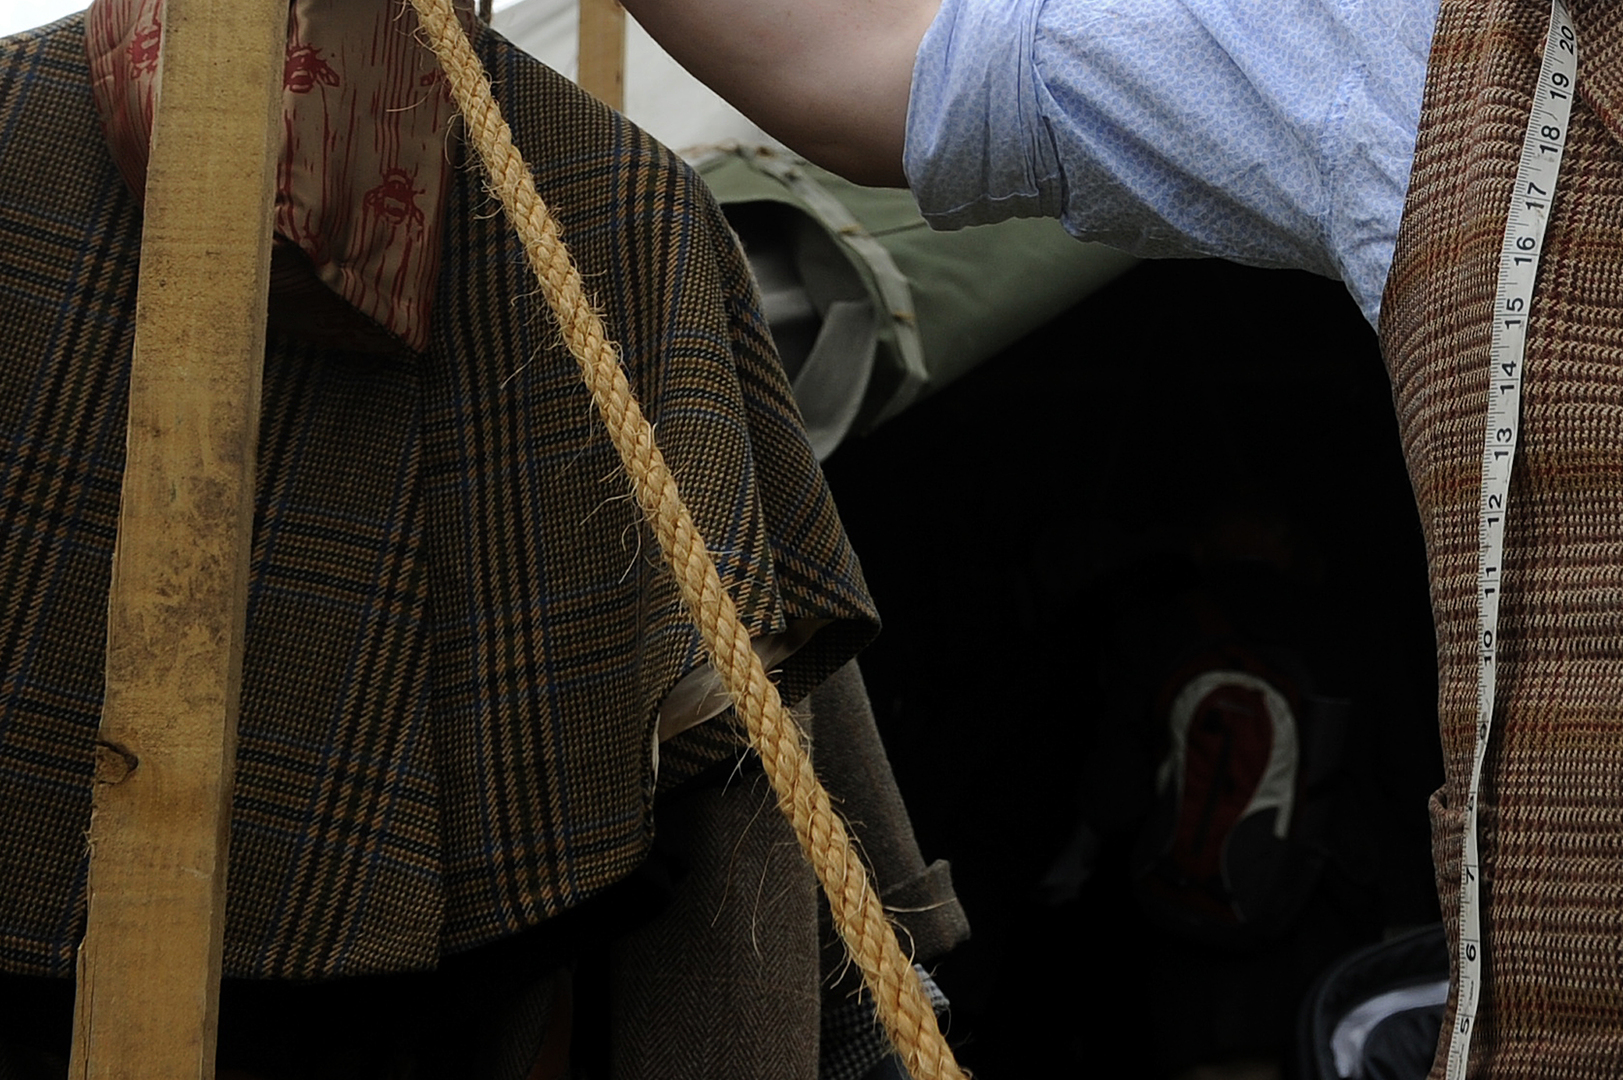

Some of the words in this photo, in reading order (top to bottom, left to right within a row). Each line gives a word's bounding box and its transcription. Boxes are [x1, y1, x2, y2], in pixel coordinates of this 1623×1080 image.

[1560, 25, 1575, 56] 20
[1550, 72, 1570, 101] 19
[1539, 125, 1561, 154] 18
[1526, 182, 1547, 211] 17
[1515, 236, 1536, 266] 16
[1504, 297, 1524, 329] 15
[1500, 361, 1517, 391] 14
[1494, 428, 1512, 460] 13
[1488, 494, 1502, 526] 12
[1484, 566, 1497, 599] 11
[1483, 629, 1493, 667] 10
[1466, 867, 1475, 883] 7
[1465, 943, 1477, 962] 6
